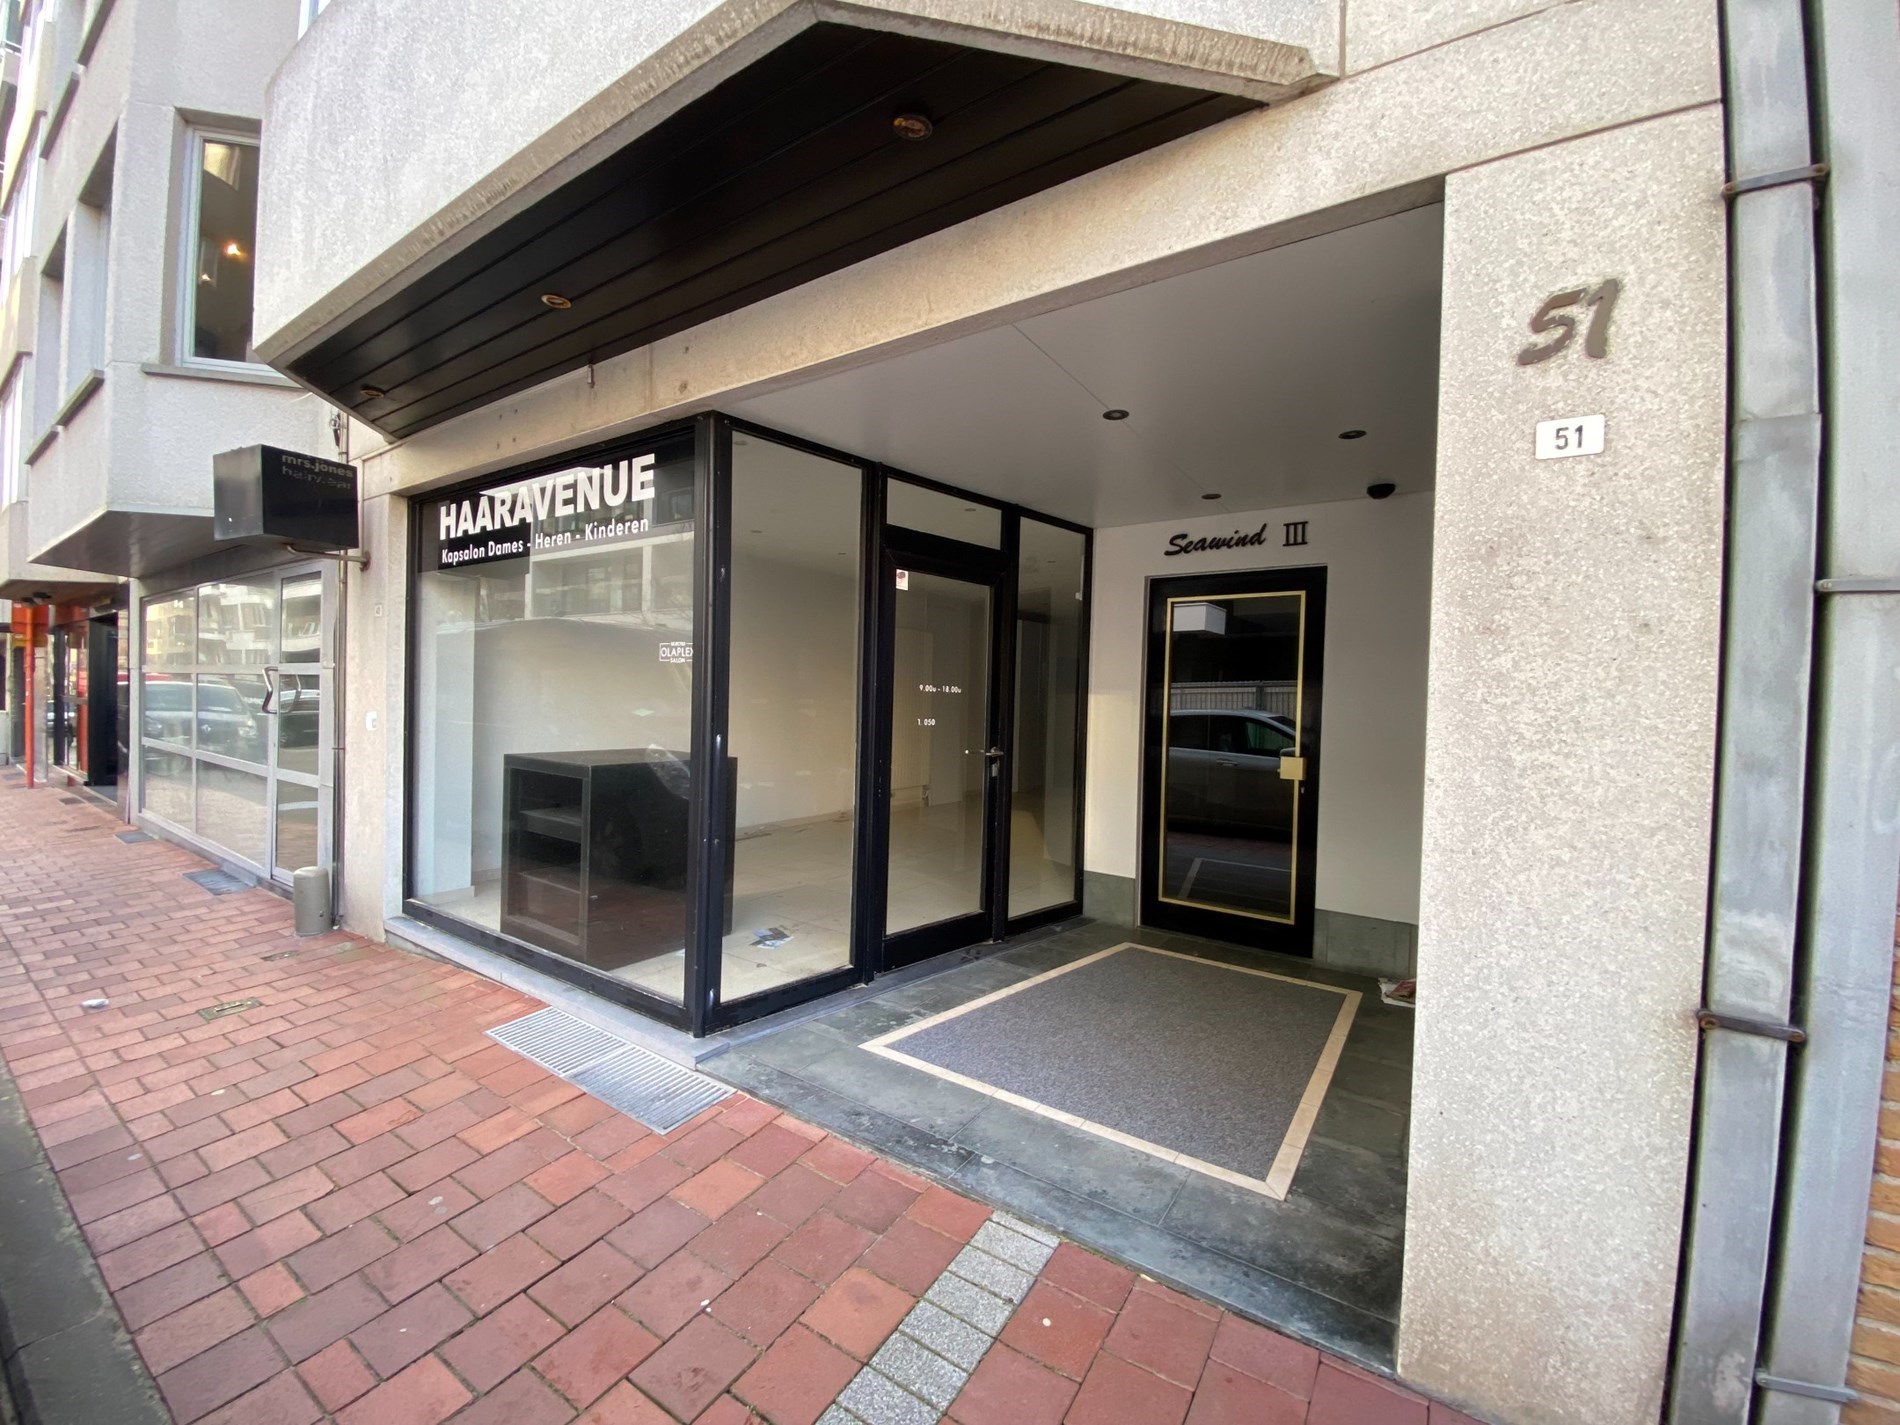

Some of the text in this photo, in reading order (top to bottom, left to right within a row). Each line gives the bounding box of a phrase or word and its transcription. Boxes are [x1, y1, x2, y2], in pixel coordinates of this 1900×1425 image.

[1516, 278, 1619, 366] 51
[1555, 424, 1584, 450] 51
[281, 455, 354, 478] mrs.jones
[439, 453, 656, 541] HAARAVENUE
[441, 546, 486, 566] Kapsalon
[488, 539, 524, 556] Dames
[535, 530, 572, 550] Heren
[584, 518, 649, 541] Kinderen
[1164, 521, 1308, 556] Seawind III
[923, 718, 936, 726] 050
